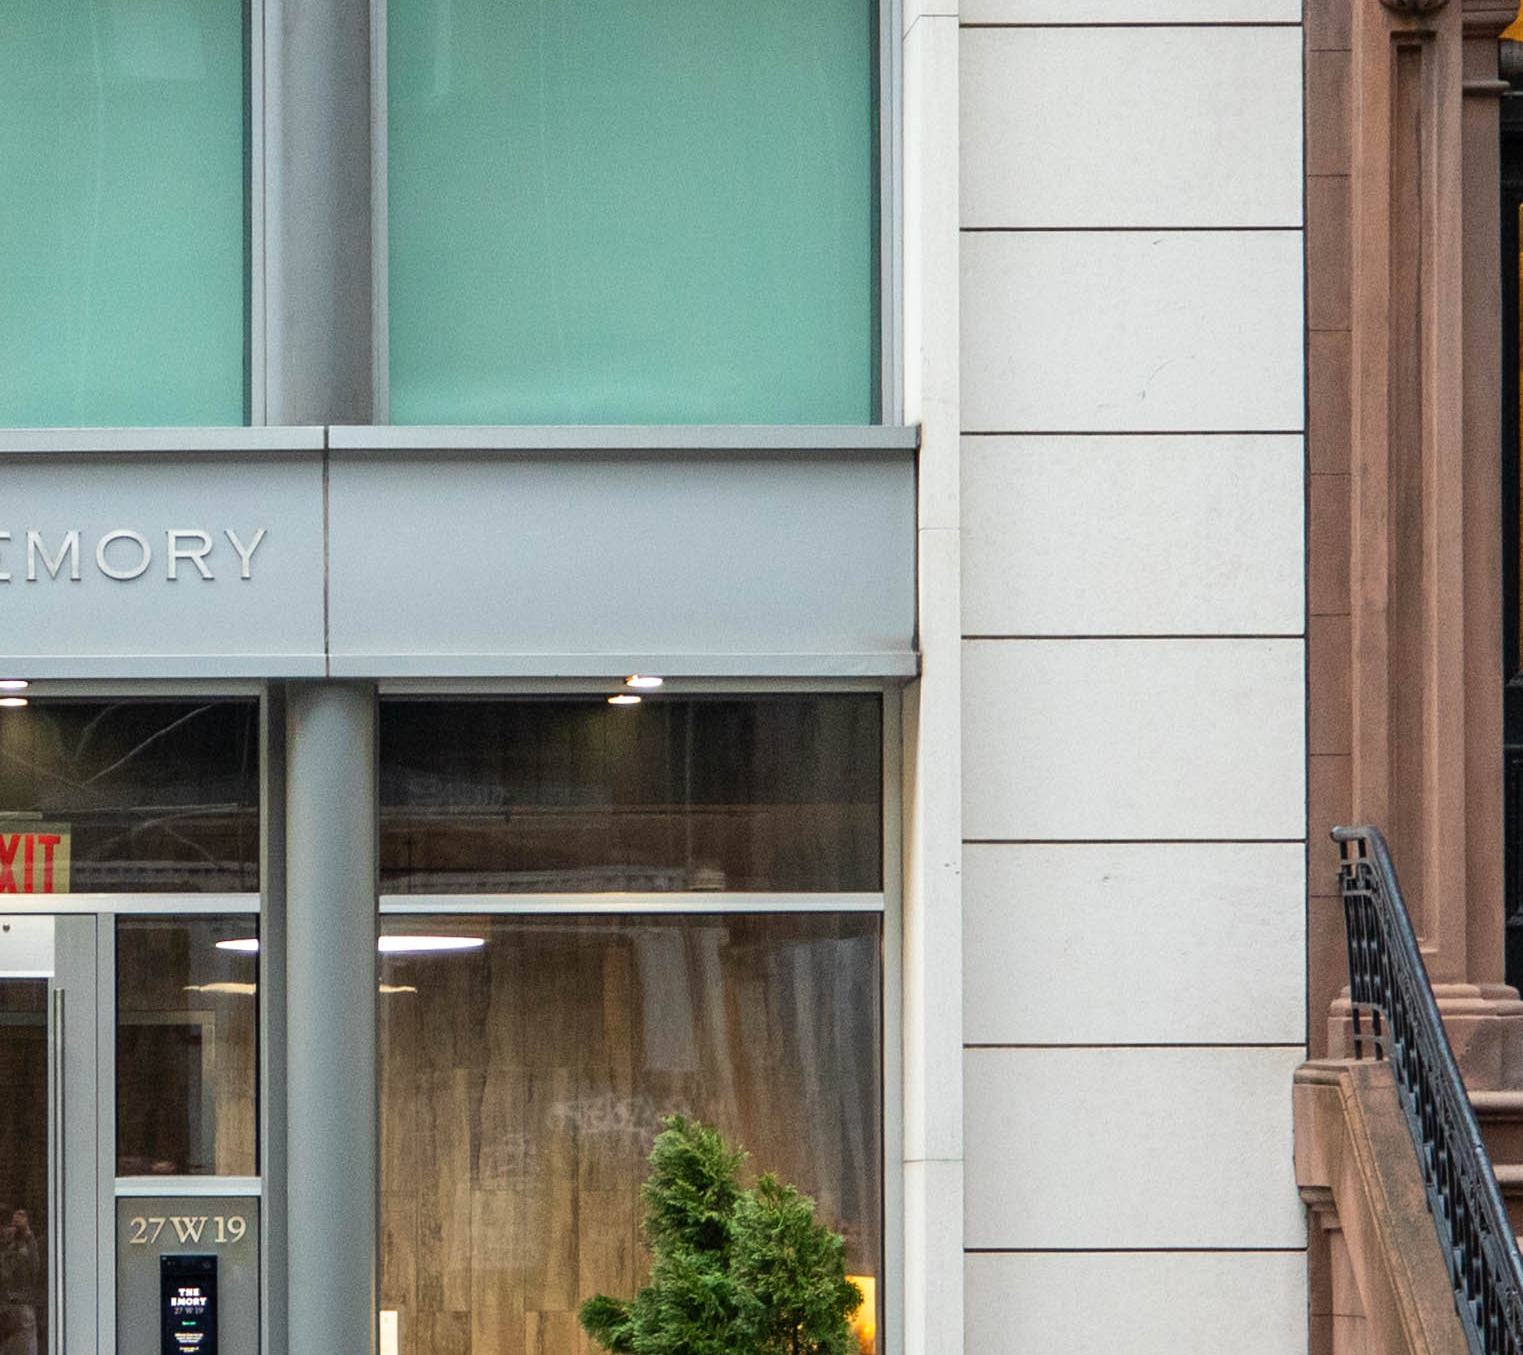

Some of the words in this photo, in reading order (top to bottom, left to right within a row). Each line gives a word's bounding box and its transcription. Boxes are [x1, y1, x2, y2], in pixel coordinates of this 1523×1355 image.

[129, 1217, 165, 1244] 27
[170, 1217, 208, 1243] W
[214, 1216, 247, 1243] 19
[178, 1288, 200, 1296] THE
[170, 1297, 207, 1306] EMORY
